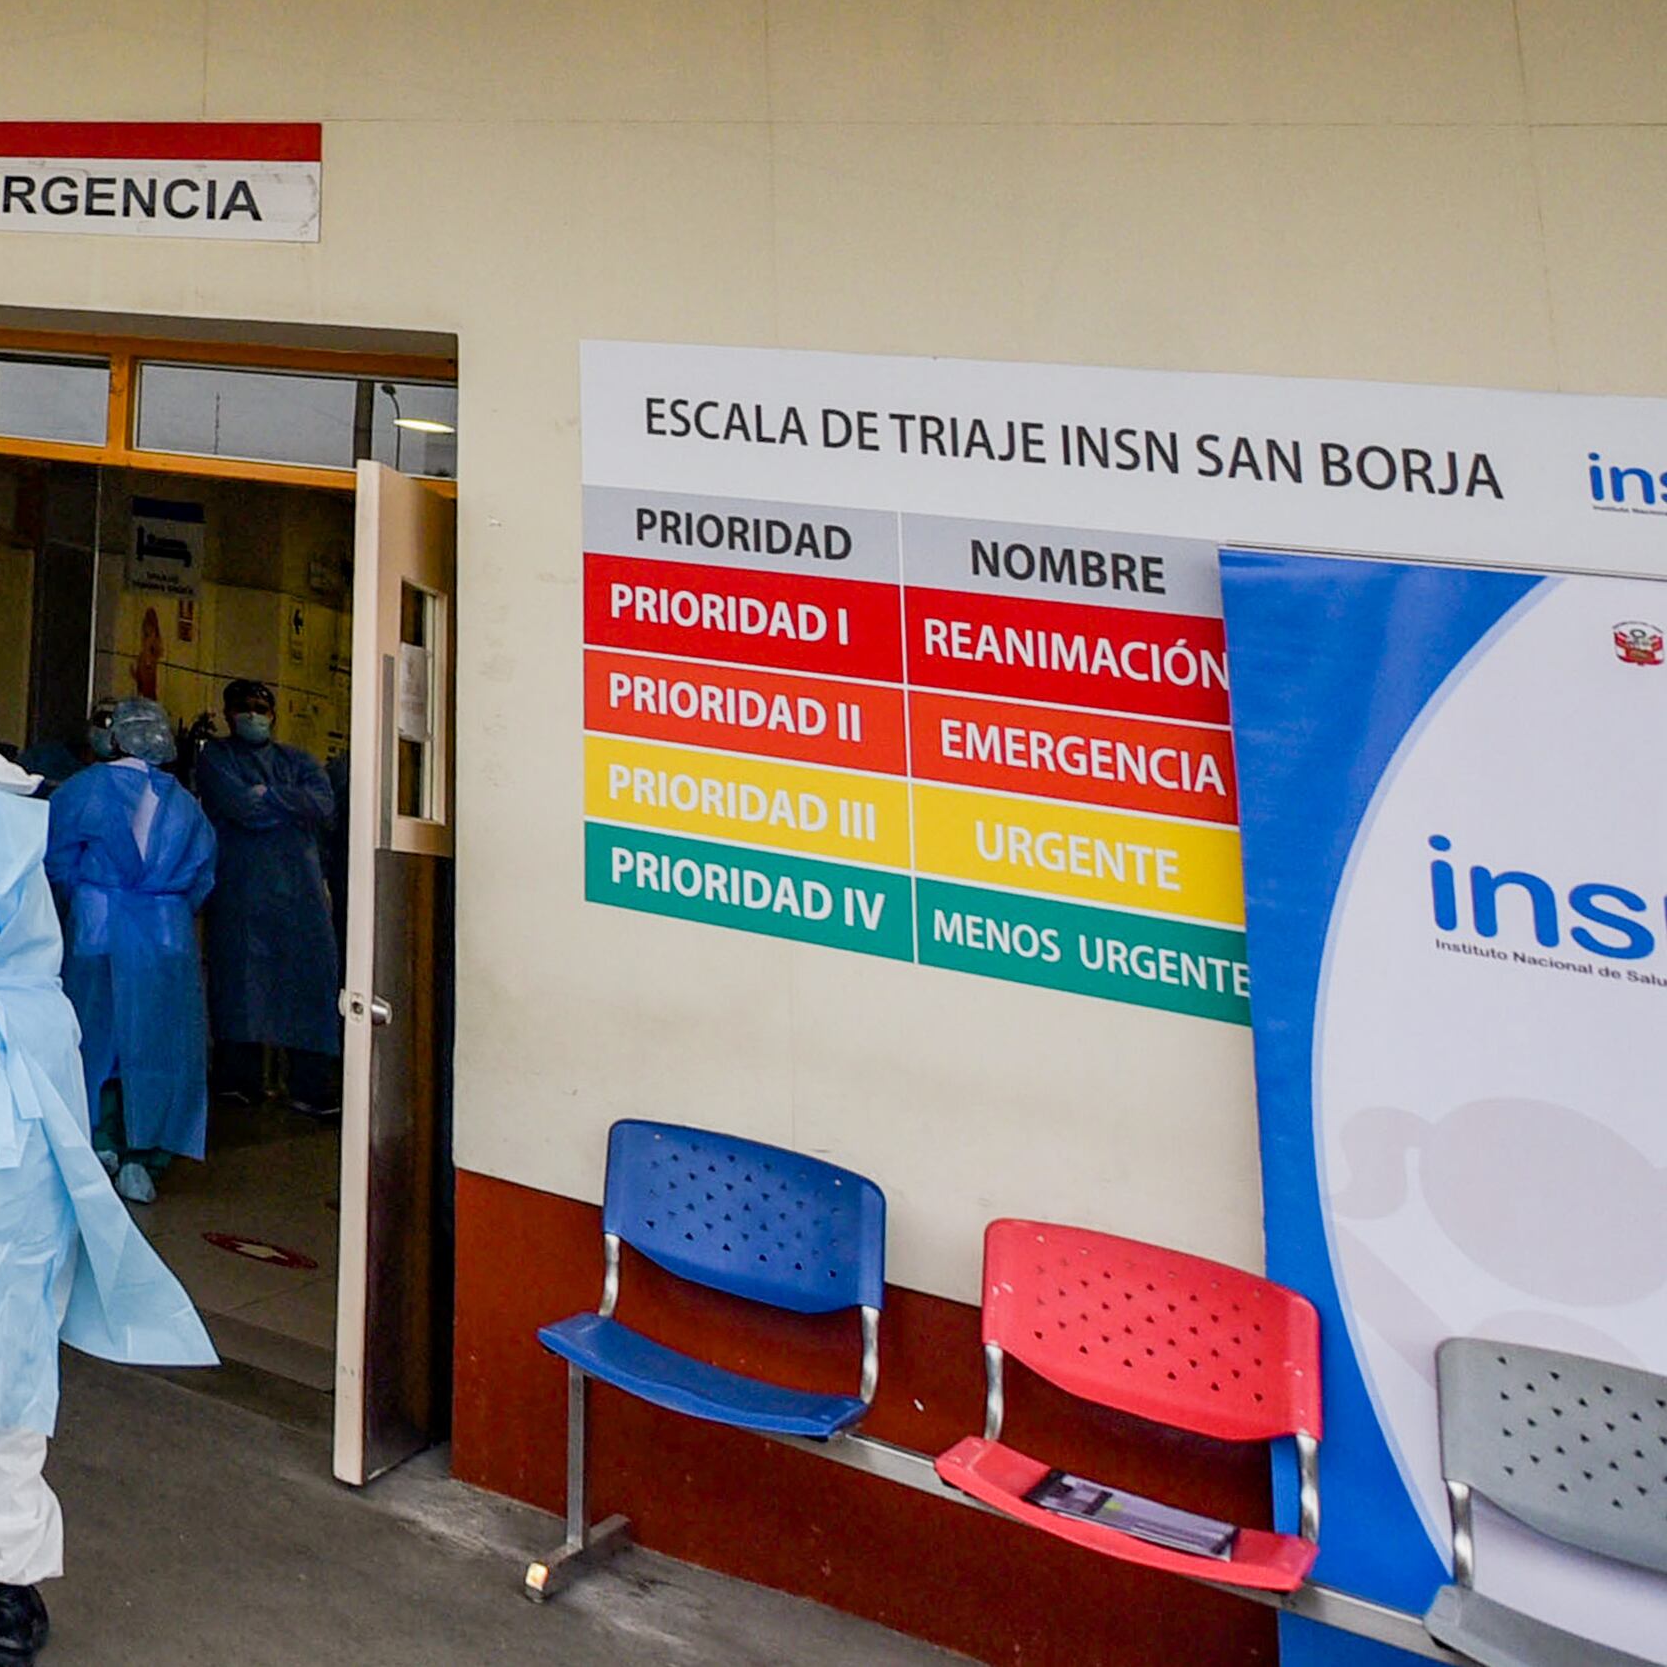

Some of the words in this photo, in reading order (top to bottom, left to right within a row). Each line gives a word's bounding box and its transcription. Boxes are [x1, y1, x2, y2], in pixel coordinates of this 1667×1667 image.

[645, 397, 809, 446] ESCALA
[821, 408, 881, 451] DE
[889, 413, 1047, 464] TRIAJE
[1060, 424, 1180, 475] INSN
[1195, 433, 1303, 484] SAN
[1319, 441, 1505, 500] BORJA
[636, 507, 853, 561] PRIORIDAD
[970, 539, 1166, 595] NOMBRE
[610, 583, 827, 642] PRIORIDAD
[837, 607, 849, 646] I
[923, 617, 1230, 691] REANIMACIÓN
[609, 672, 827, 736] PRIORIDAD
[837, 702, 861, 743] II
[940, 718, 1227, 796] EMERGENCIA
[608, 763, 828, 832] PRIORIDAD
[839, 799, 876, 842] III
[611, 846, 833, 921] PRIORIDAD
[844, 887, 886, 932] IV
[974, 820, 1181, 892] URGENTE
[1428, 834, 1667, 960] ins
[933, 909, 1062, 963] MENOS
[1079, 934, 1251, 999] URGENTE
[1435, 937, 1508, 961] Instituto
[1513, 951, 1593, 975] Nacional
[1598, 966, 1622, 980] de
